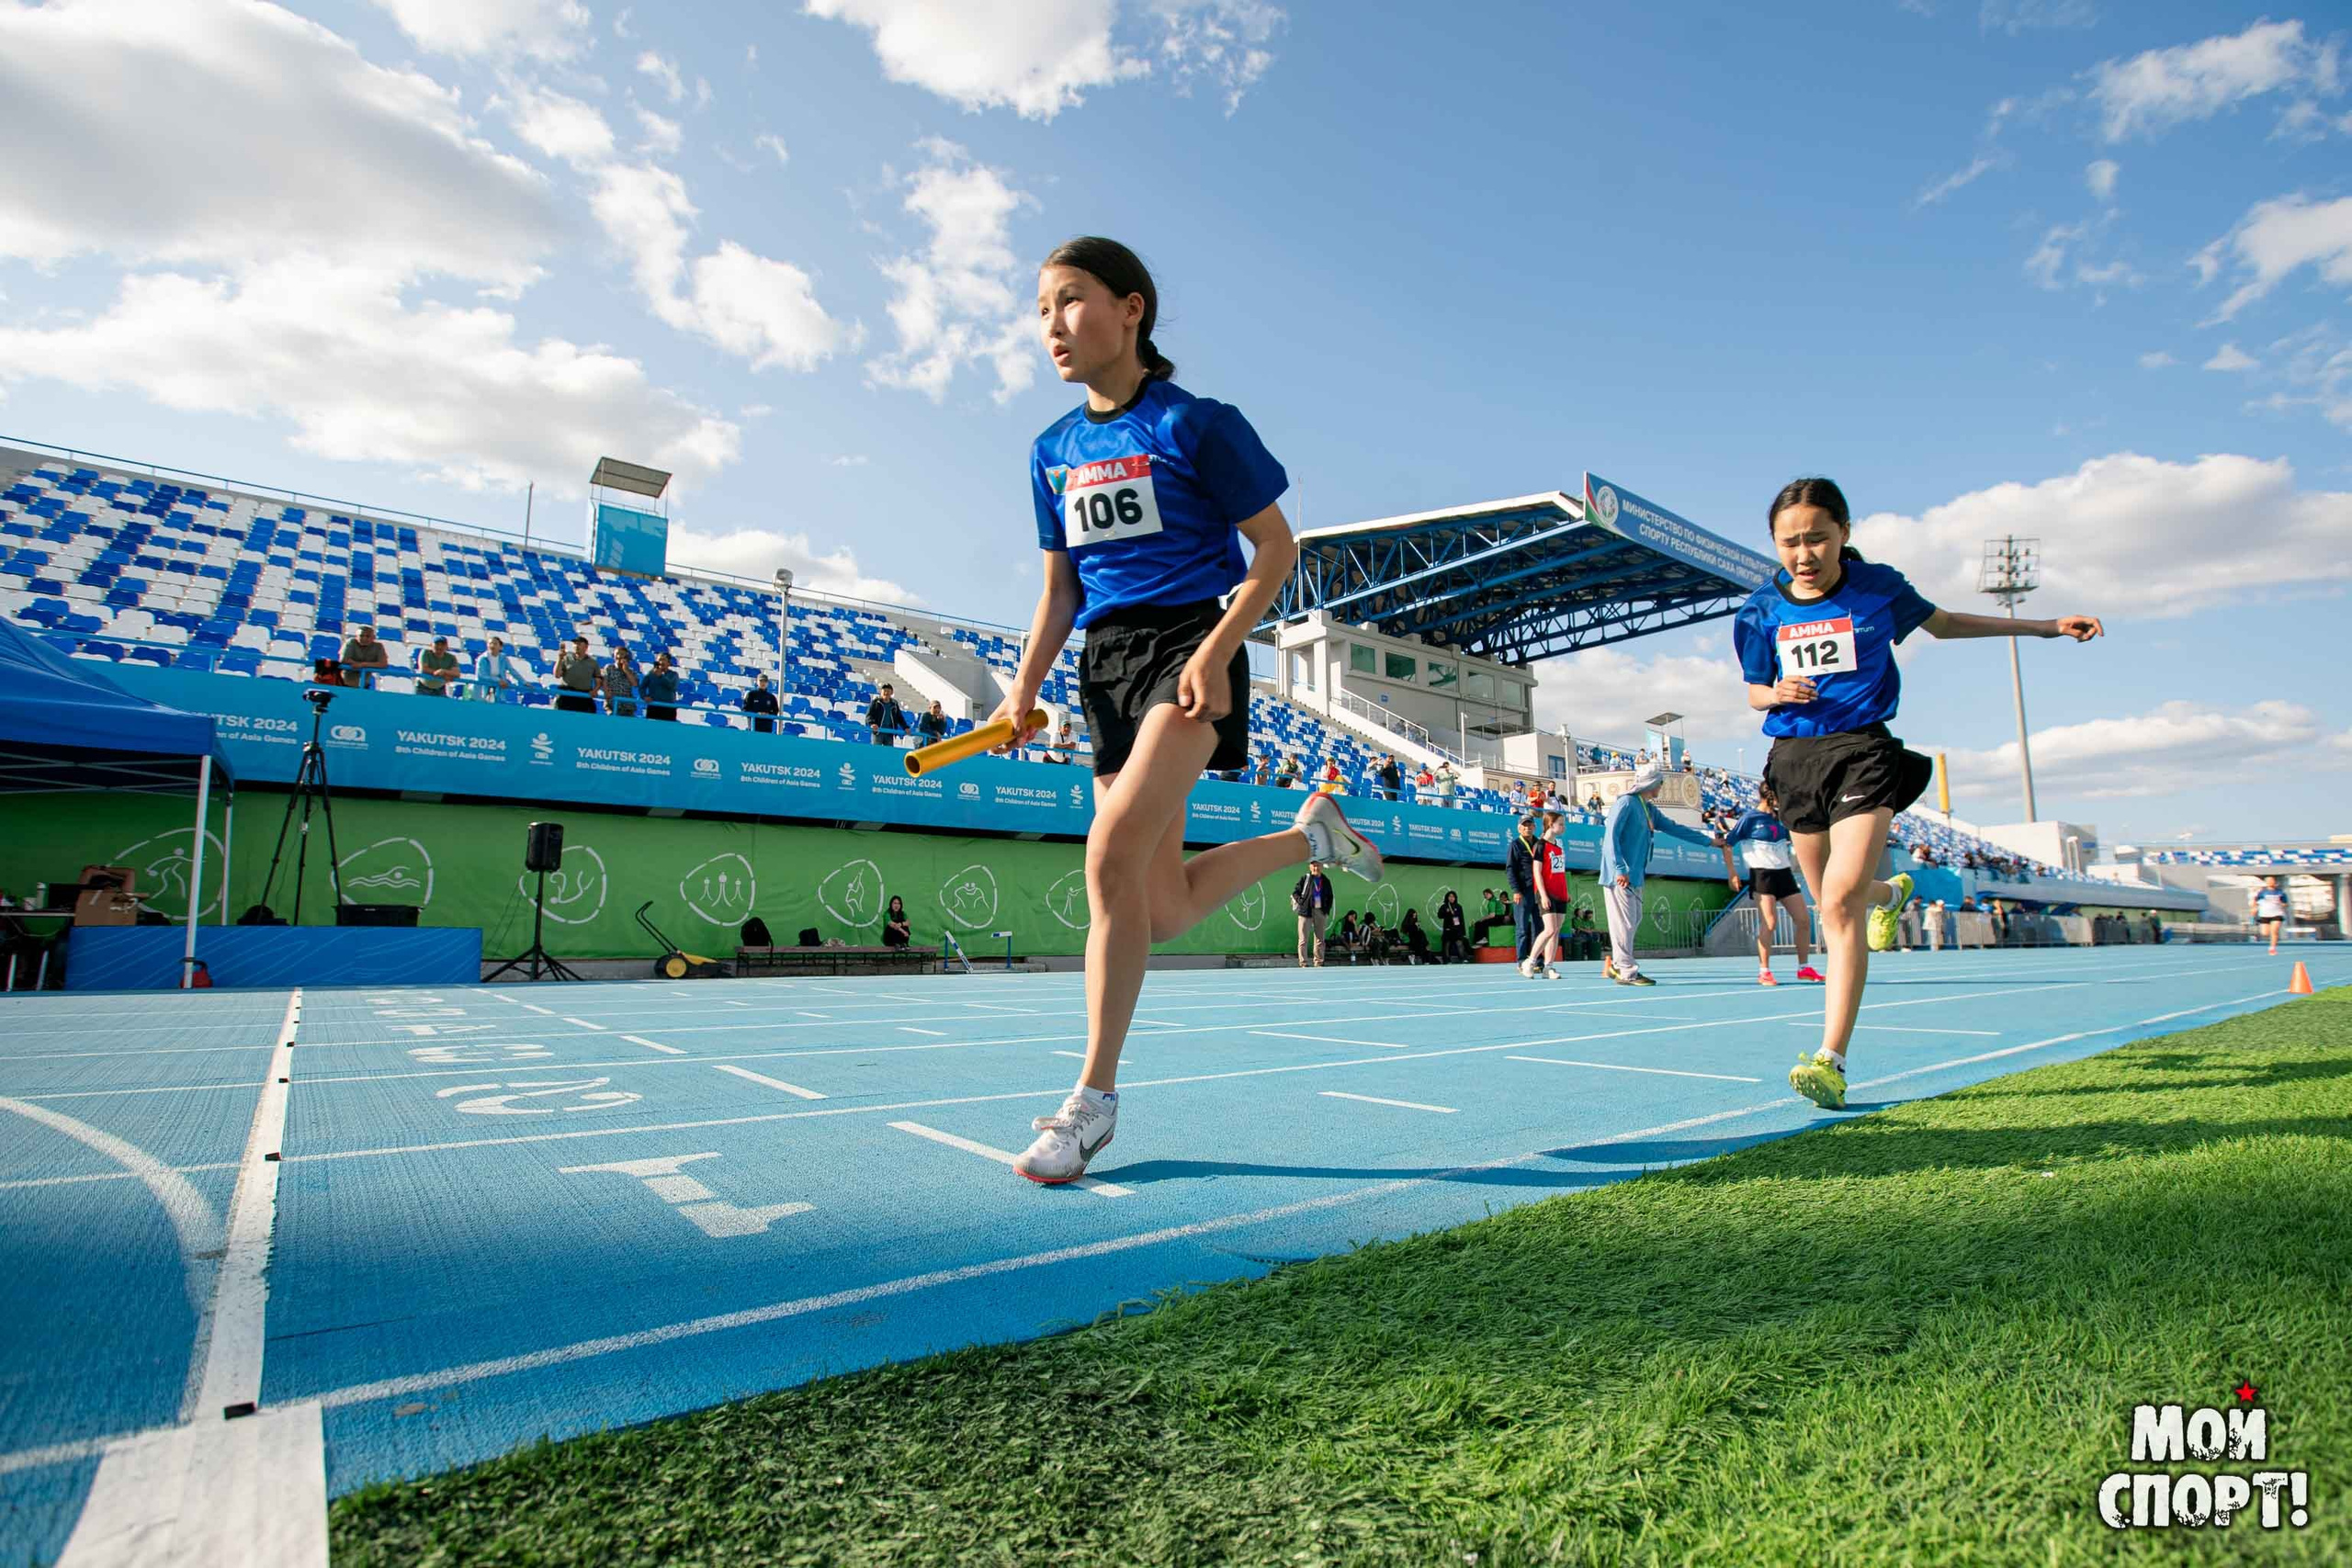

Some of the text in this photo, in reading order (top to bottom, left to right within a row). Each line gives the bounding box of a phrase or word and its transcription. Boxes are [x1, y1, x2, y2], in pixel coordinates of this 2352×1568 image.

[1077, 462, 1127, 486] AMMA
[1073, 488, 1143, 532] 106
[1622, 498, 1683, 536] МИНИСТЕРСТВО
[1683, 527, 1695, 541] ПО
[1639, 522, 1669, 546] СПОРТУ
[1789, 622, 1835, 638] AMMA
[1791, 639, 1839, 669] 112
[253, 717, 298, 733] 2024
[396, 729, 507, 751] YAKUTSK 2024
[412, 746, 447, 758] Children
[576, 747, 672, 766] YAKUTSK 2024
[590, 761, 620, 773] Children
[741, 761, 821, 779] YAKUTSK 2024
[872, 773, 943, 790] YAKUTSK 2024
[995, 784, 1035, 798] YAKUTSK
[1035, 788, 1057, 799] 2024
[1192, 802, 1240, 815] YAKUTSK 2024
[435, 1075, 643, 1116] 2
[558, 1151, 816, 1238] 1
